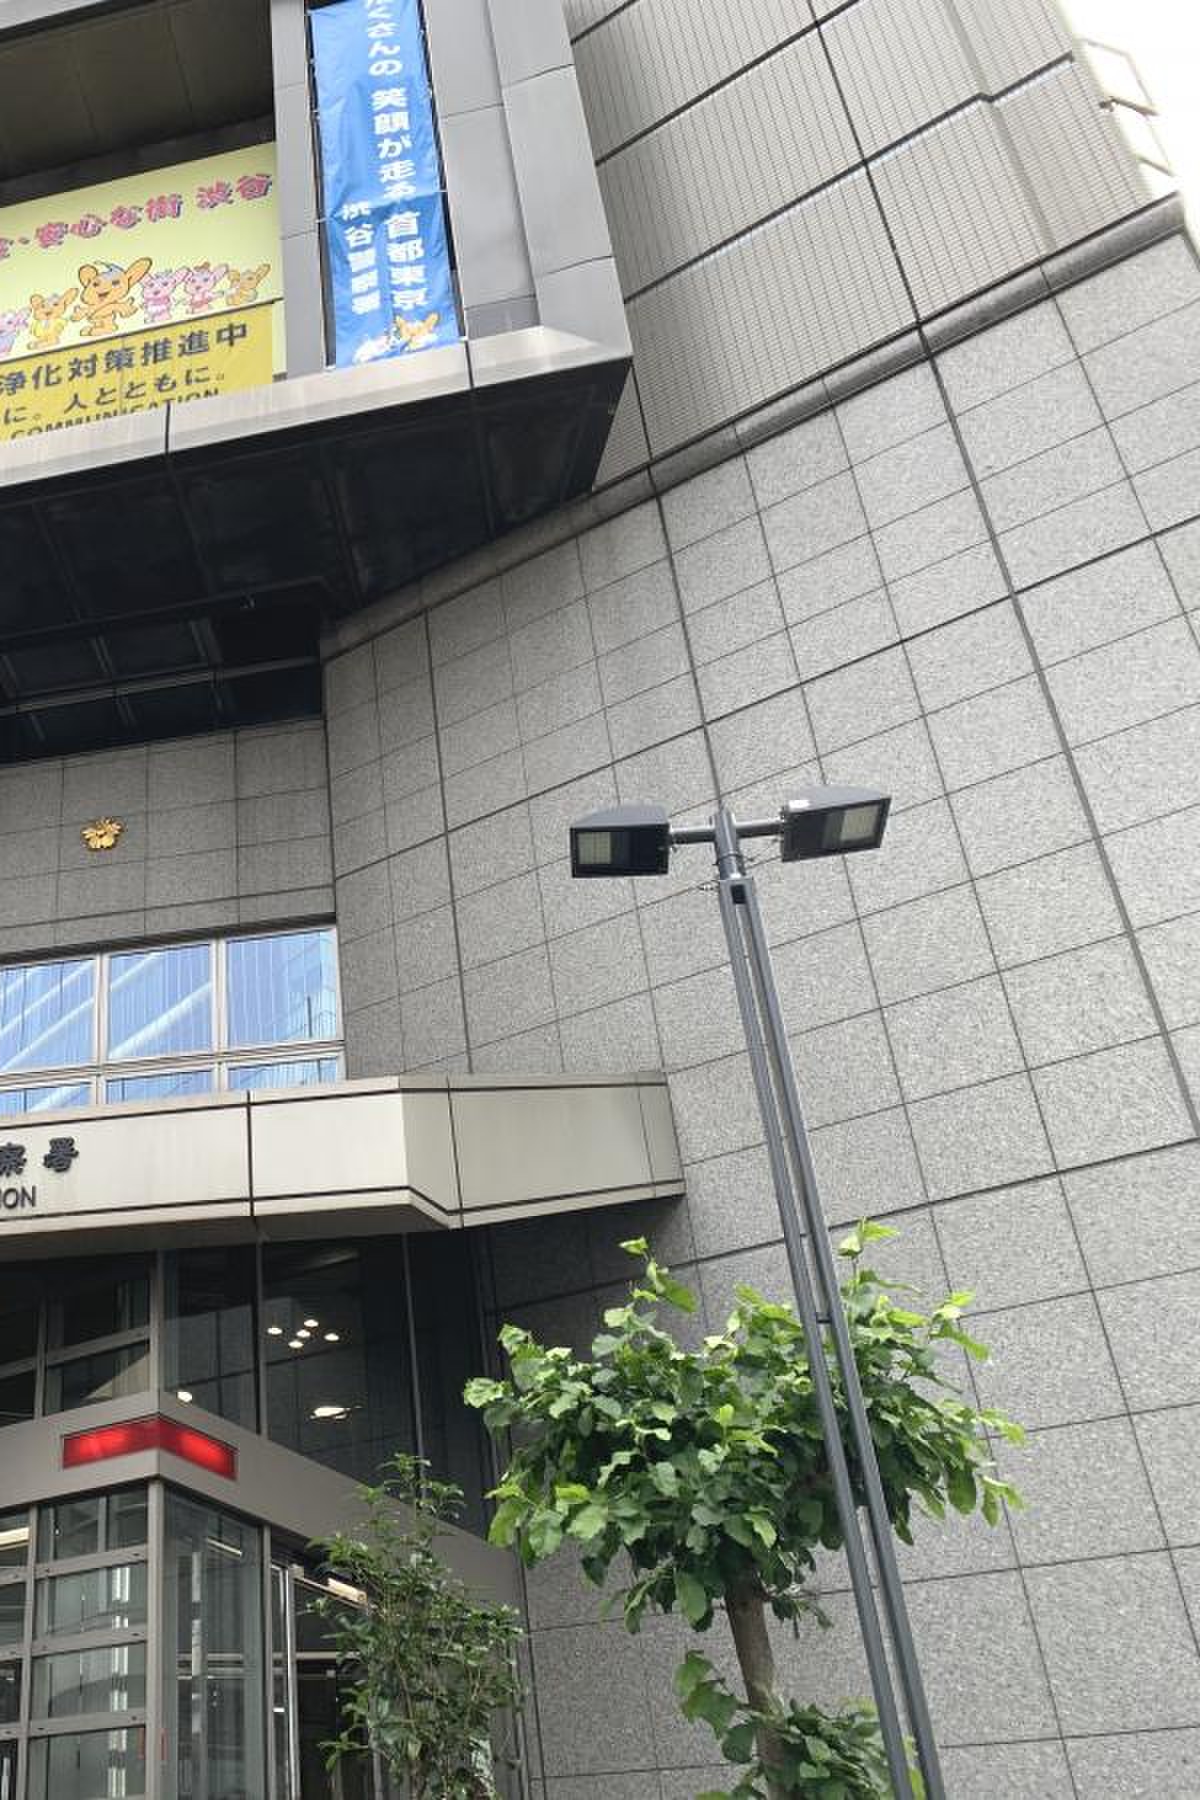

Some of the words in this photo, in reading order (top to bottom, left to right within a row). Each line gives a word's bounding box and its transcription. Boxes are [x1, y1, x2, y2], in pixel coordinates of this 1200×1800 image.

[196, 173, 272, 208] 渋谷
[386, 211, 429, 311] 首都東京
